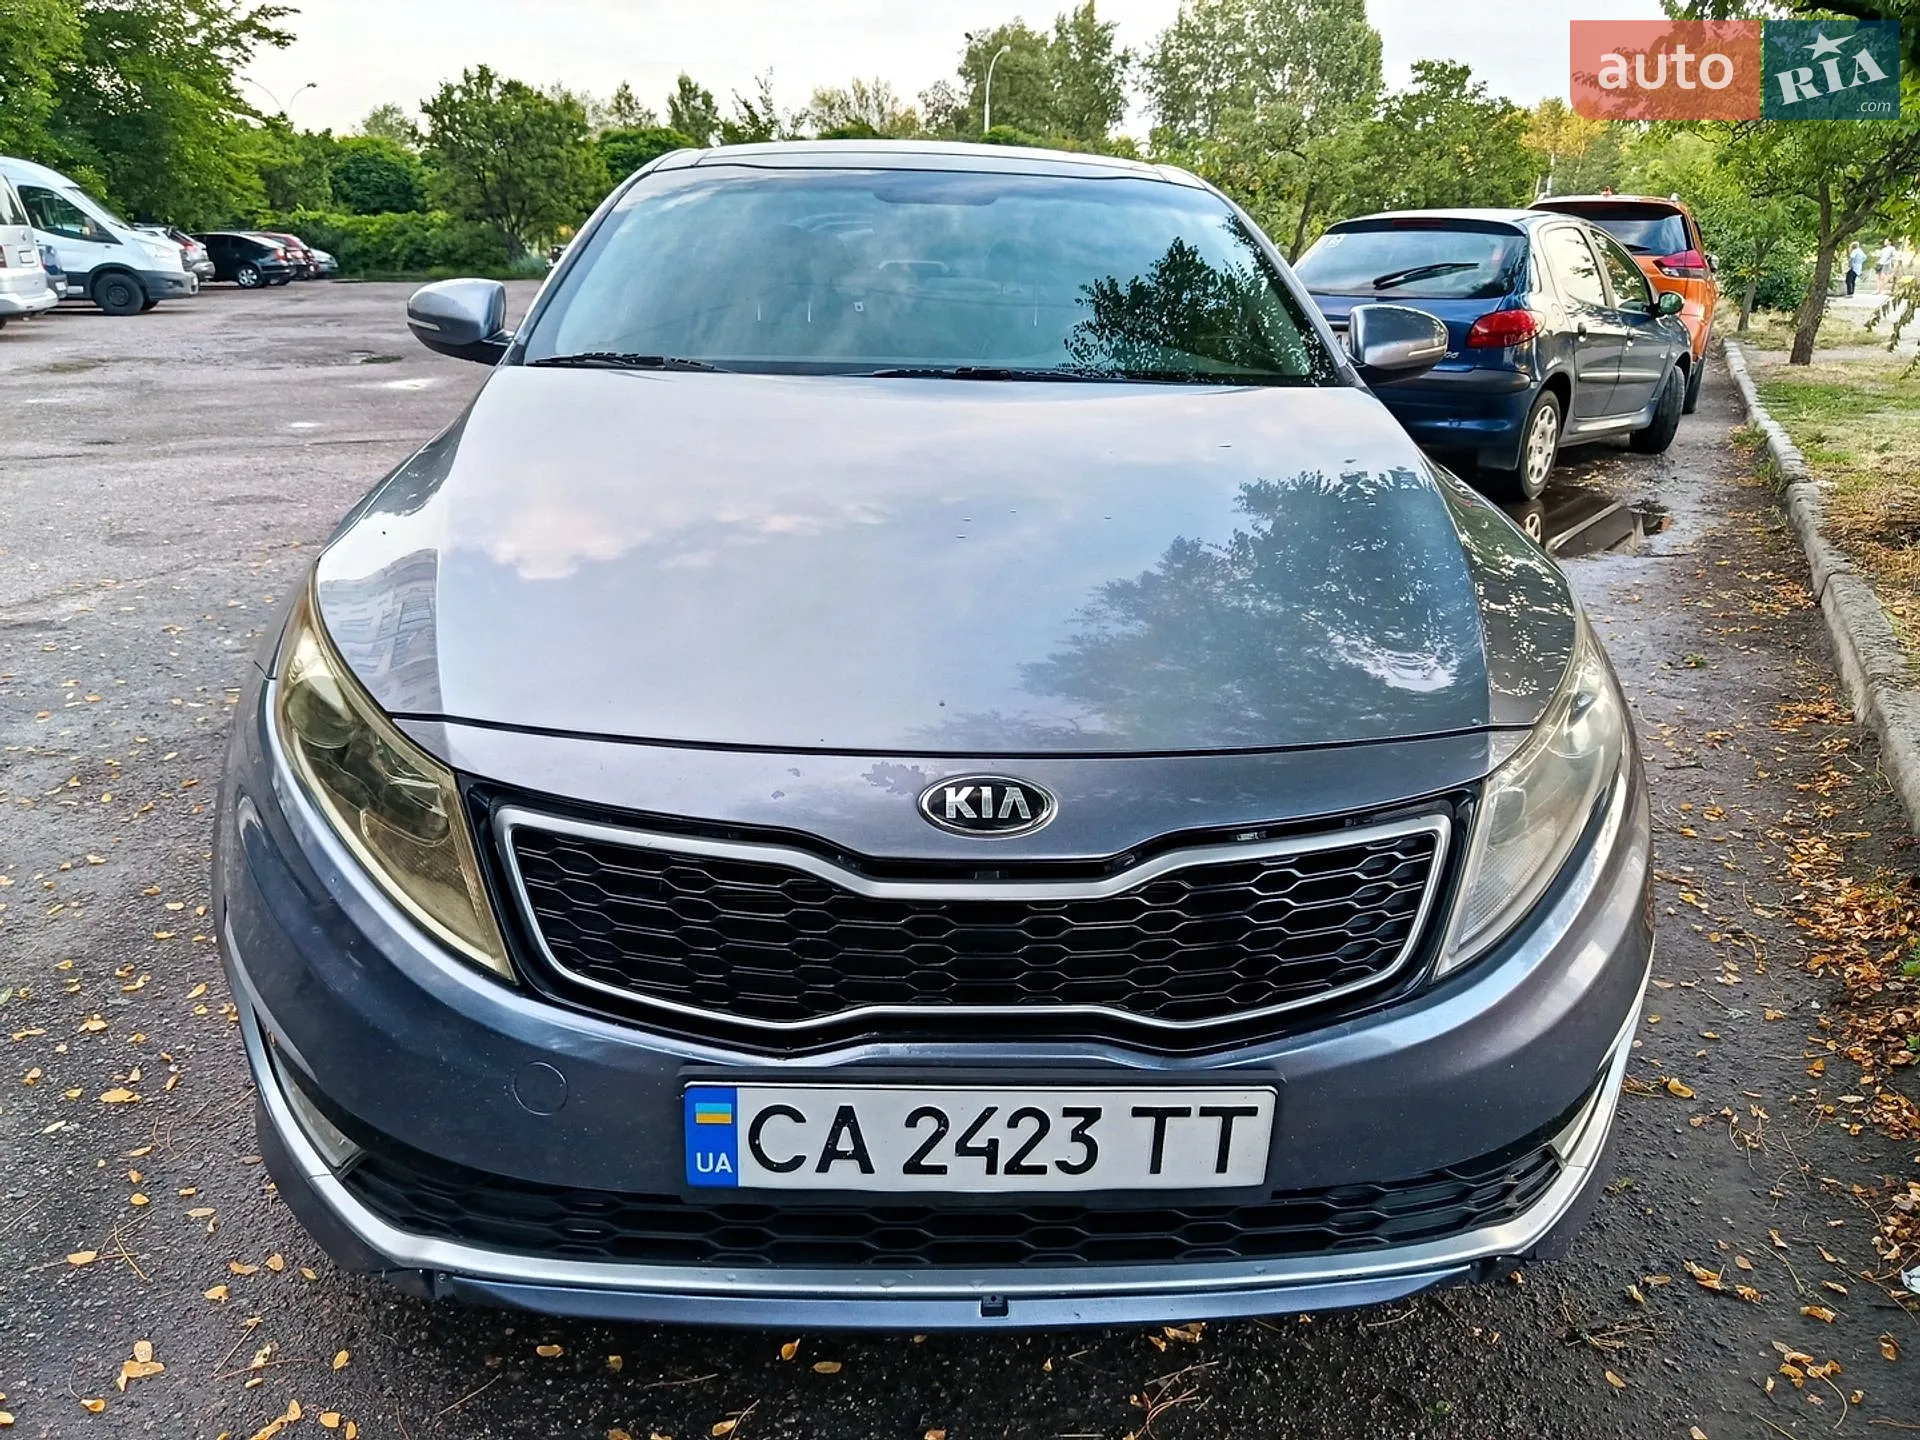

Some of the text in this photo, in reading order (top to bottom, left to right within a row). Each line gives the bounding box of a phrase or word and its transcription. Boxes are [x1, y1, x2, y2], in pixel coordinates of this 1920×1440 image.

[944, 786, 1032, 819] KIA
[748, 1104, 1258, 1176] CA 2423 TT
[696, 1152, 733, 1173] UA
